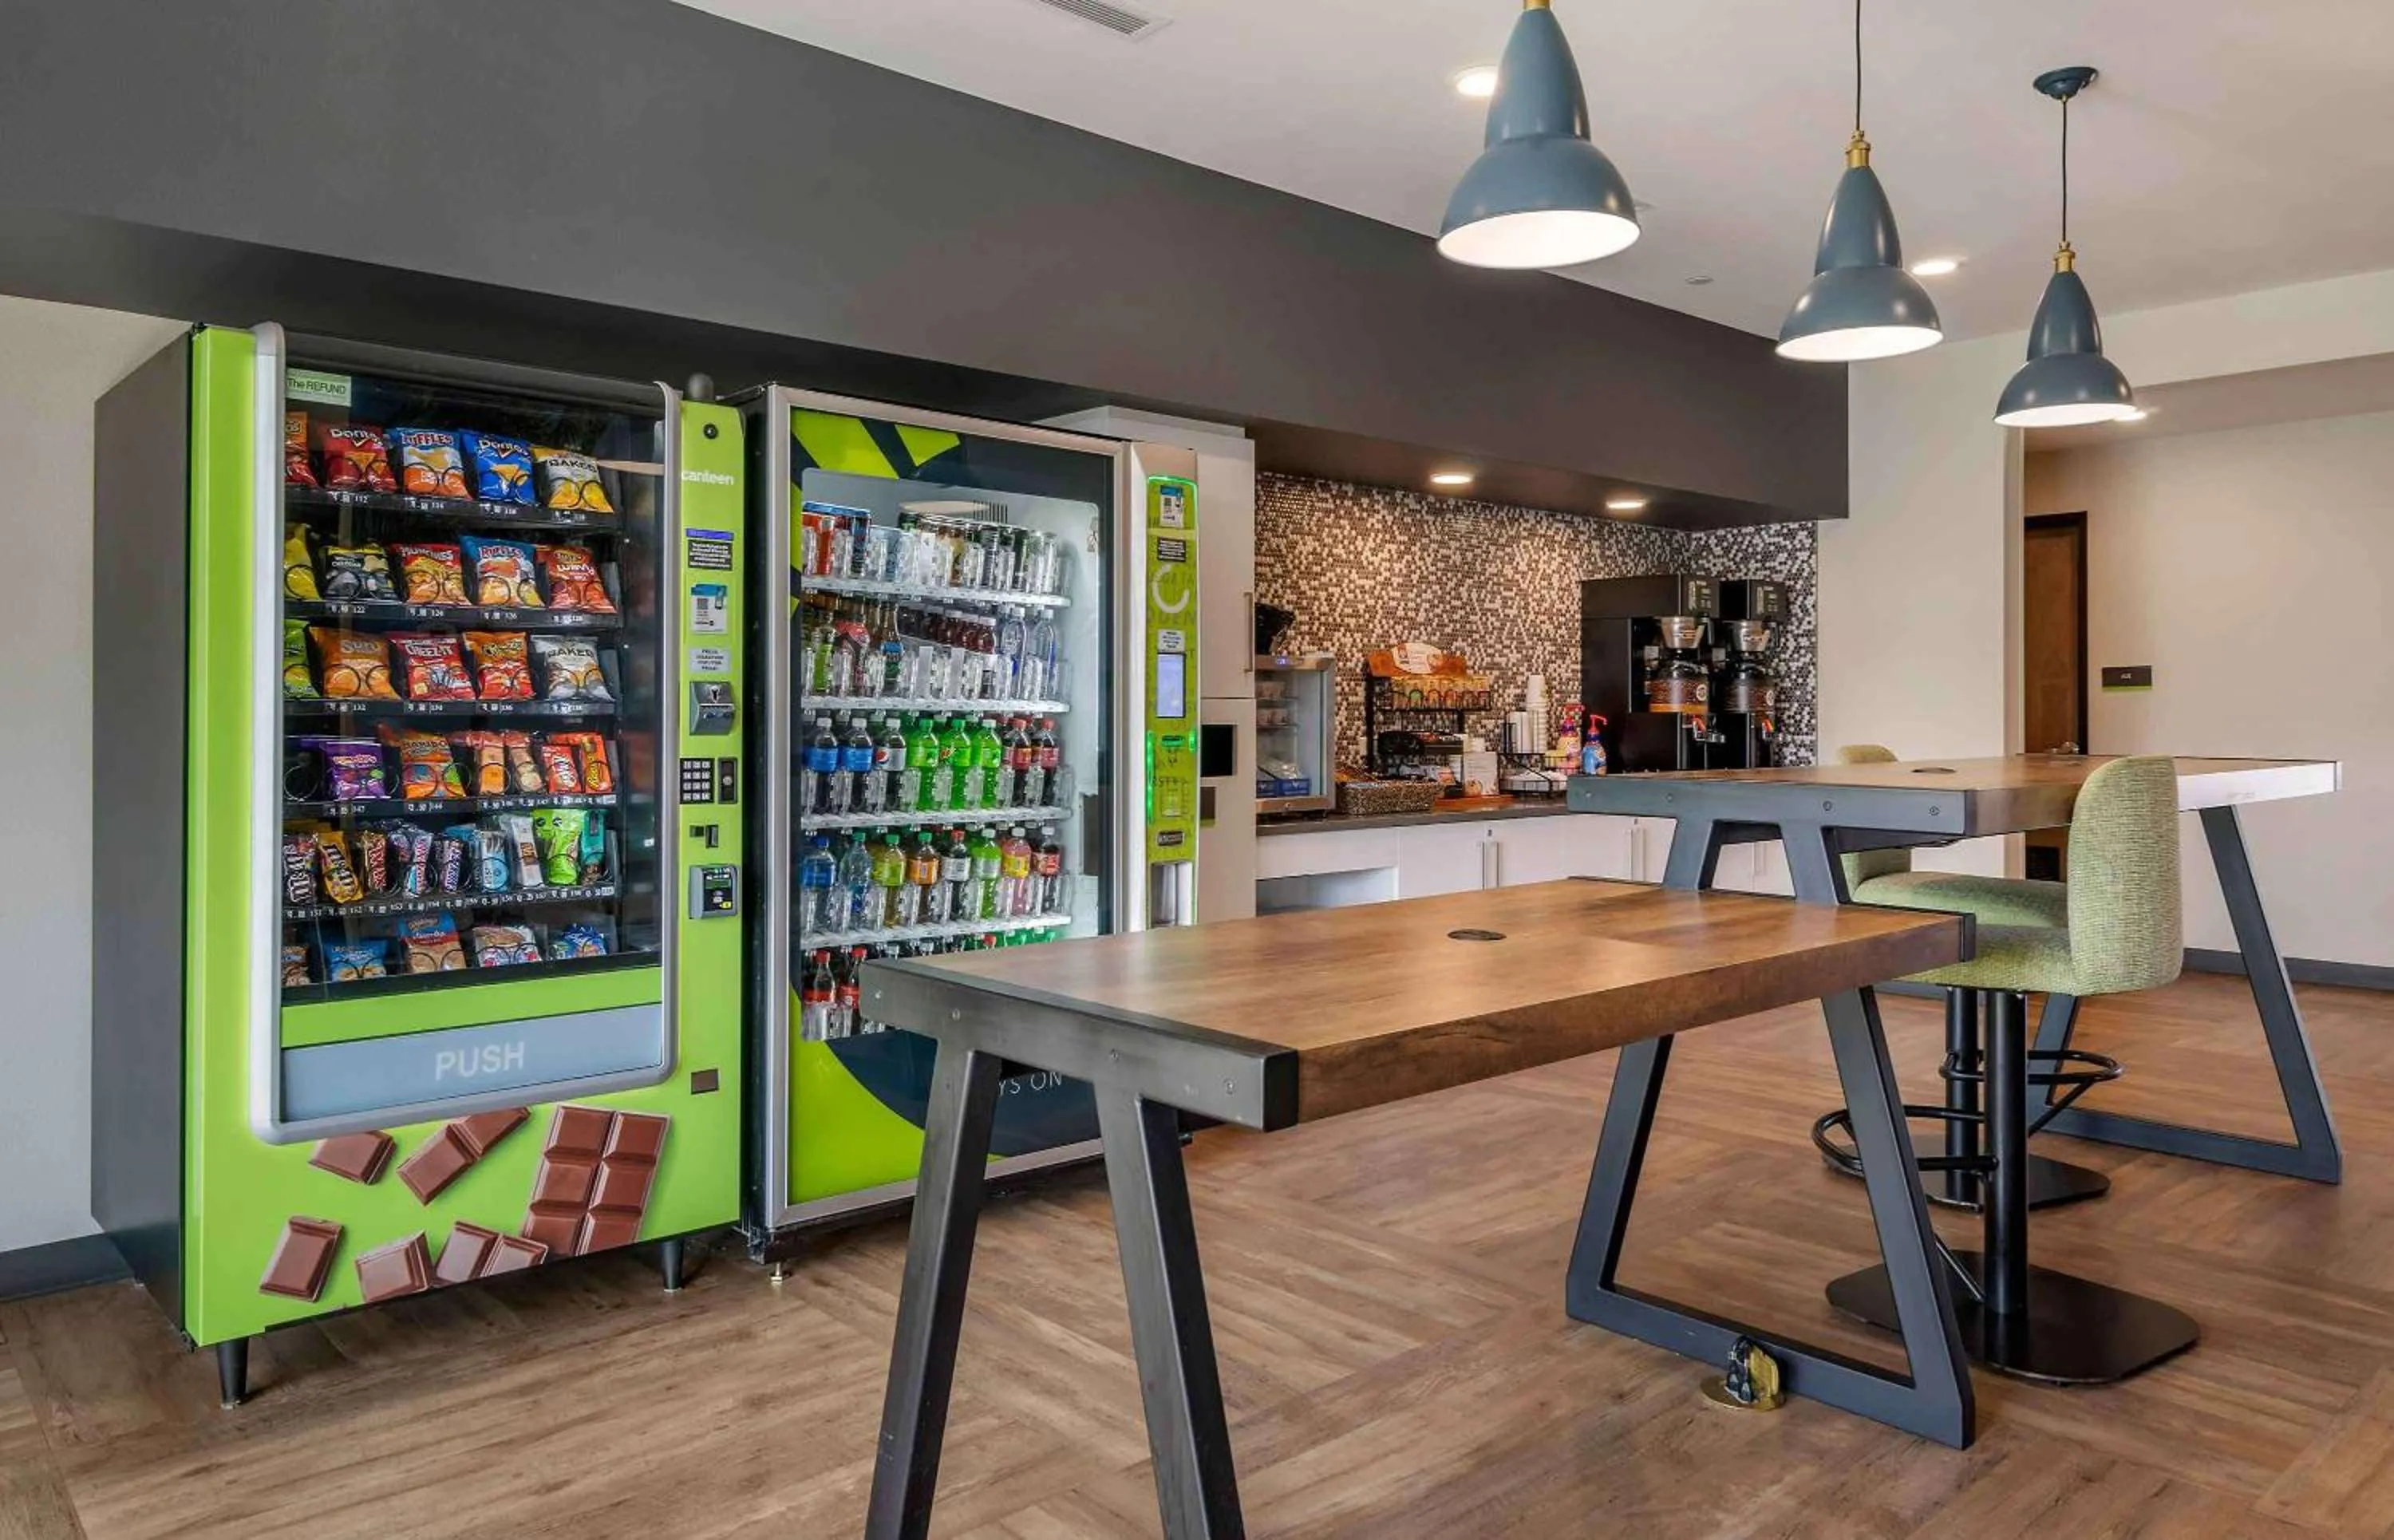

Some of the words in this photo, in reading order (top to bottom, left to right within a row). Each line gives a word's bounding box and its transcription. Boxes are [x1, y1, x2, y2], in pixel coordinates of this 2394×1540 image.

[287, 378, 305, 389] The
[306, 380, 346, 394] REFUND
[549, 458, 598, 473] BAKED
[681, 470, 734, 485] canteen
[547, 647, 595, 658] BAKED
[436, 1041, 524, 1081] PUSH
